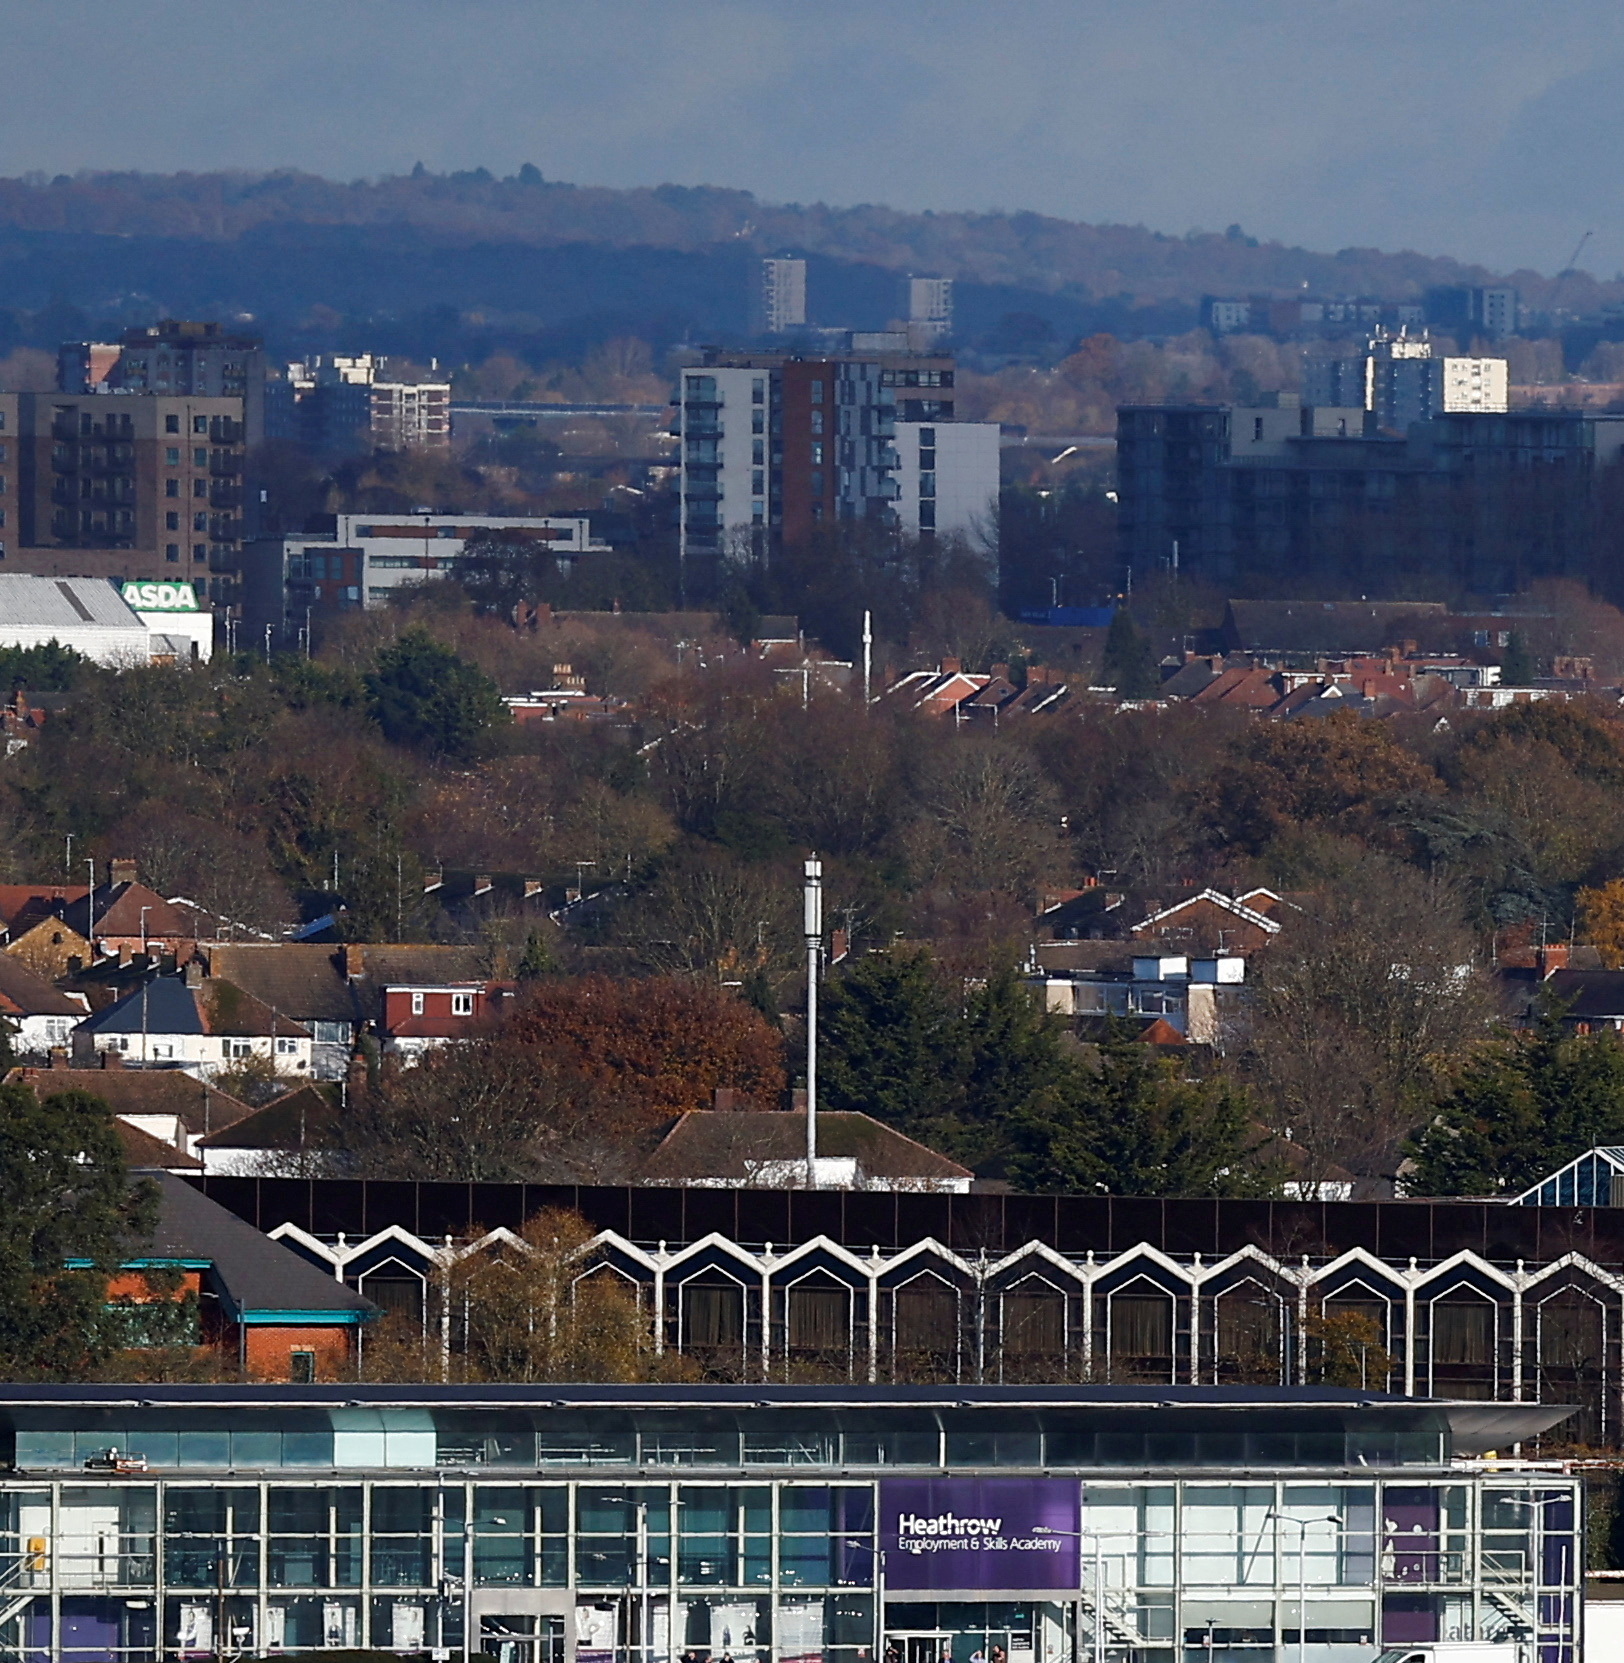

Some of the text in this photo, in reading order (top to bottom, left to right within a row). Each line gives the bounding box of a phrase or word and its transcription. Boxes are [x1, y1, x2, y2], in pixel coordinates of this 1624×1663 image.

[124, 584, 196, 608] ASDA
[899, 1512, 1001, 1535] Heathrow
[898, 1537, 1061, 1553] Employment & Skills Academy
